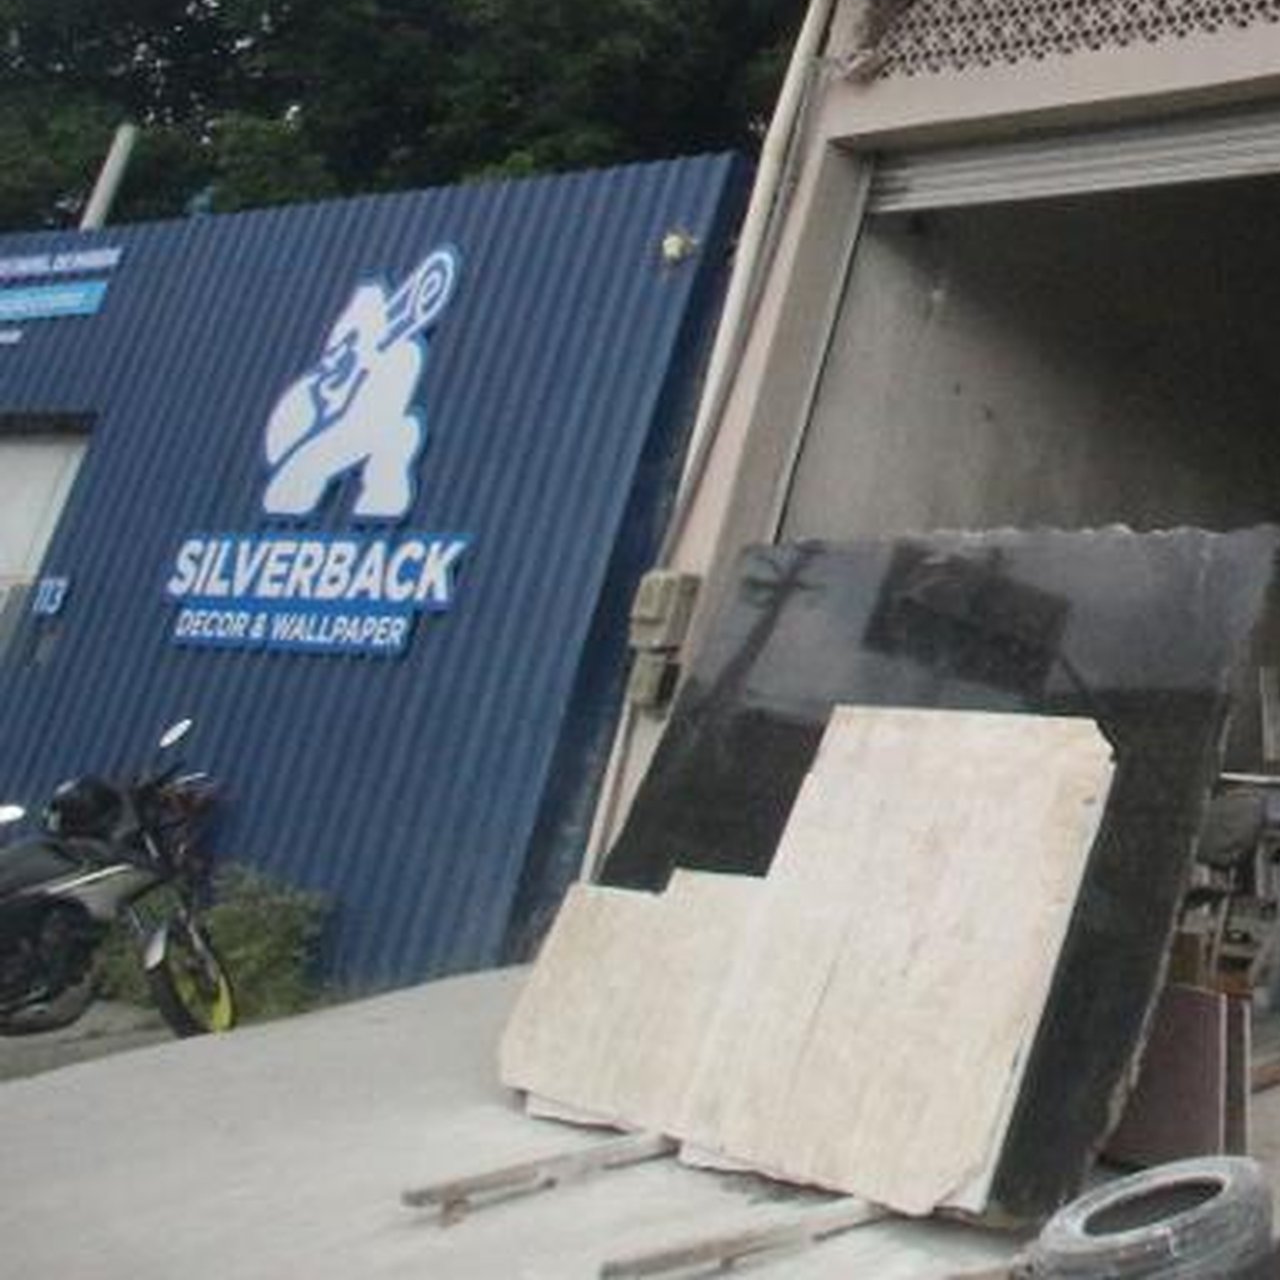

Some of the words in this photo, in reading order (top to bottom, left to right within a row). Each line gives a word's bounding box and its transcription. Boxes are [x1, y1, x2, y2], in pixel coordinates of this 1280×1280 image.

[167, 538, 466, 602] SILVERBACK
[175, 611, 248, 638] DECOR
[249, 614, 268, 639] &
[270, 613, 408, 647] WALLPAPER
